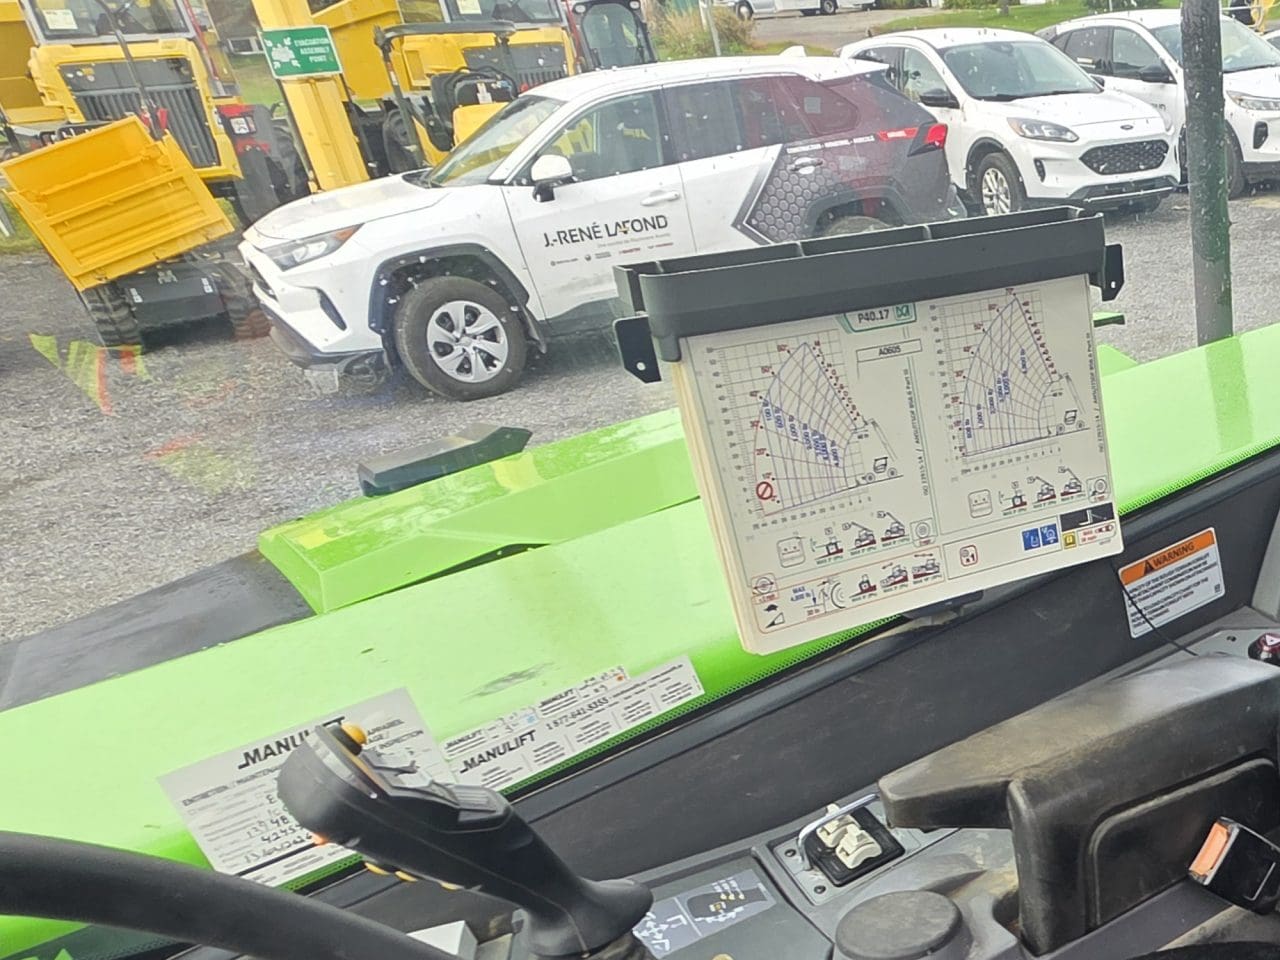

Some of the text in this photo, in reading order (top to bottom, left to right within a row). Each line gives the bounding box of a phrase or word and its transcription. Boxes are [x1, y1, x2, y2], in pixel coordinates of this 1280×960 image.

[543, 222, 603, 247] J.-RENÉ
[604, 215, 668, 237] LAFOND
[858, 309, 890, 323] P40.17
[1153, 541, 1194, 567] WARNING
[460, 729, 536, 774] MANULIFT
